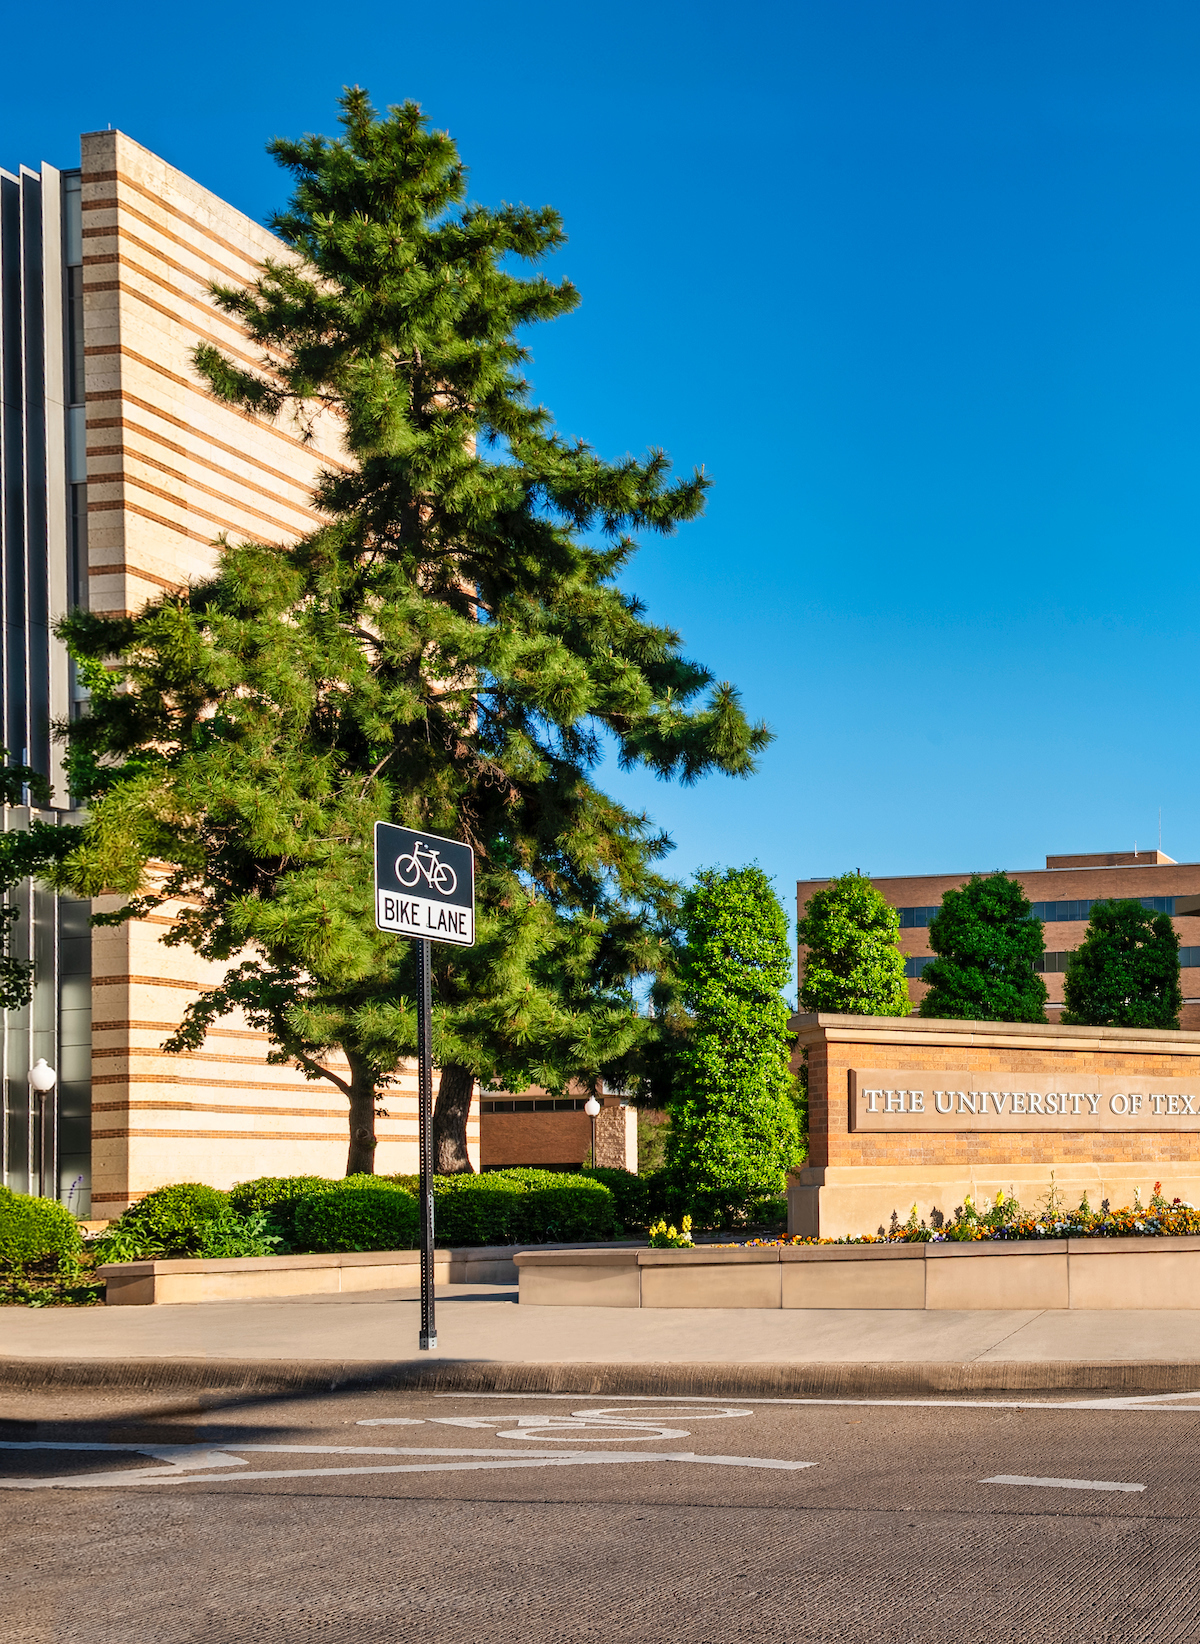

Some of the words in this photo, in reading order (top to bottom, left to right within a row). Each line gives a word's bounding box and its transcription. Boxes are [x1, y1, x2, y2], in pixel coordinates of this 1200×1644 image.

[384, 897, 420, 926] BIKE
[427, 906, 467, 935] LANE
[862, 1088, 925, 1113] THE
[933, 1090, 1102, 1114] UNIVERSITY
[1109, 1093, 1142, 1115] OF
